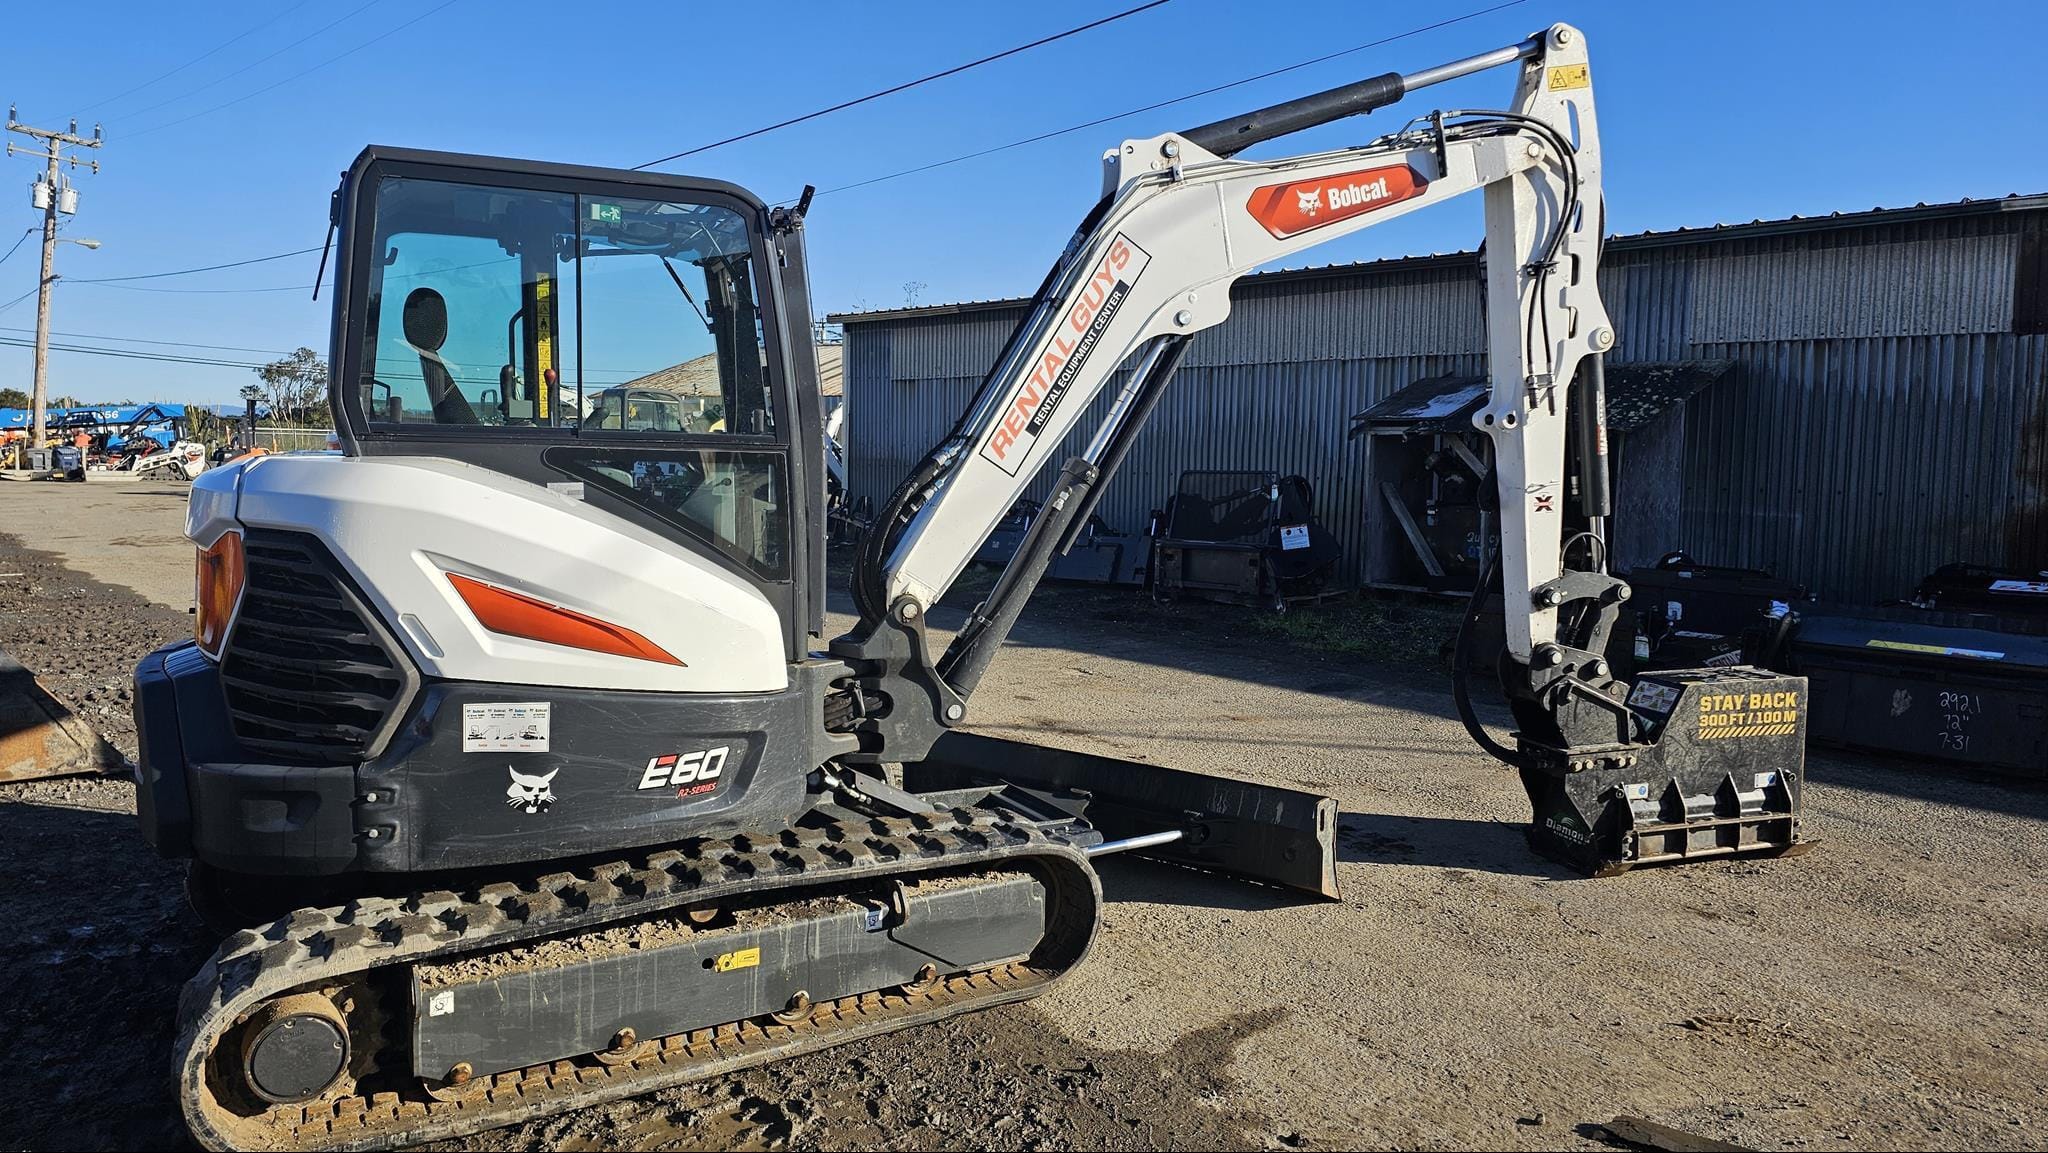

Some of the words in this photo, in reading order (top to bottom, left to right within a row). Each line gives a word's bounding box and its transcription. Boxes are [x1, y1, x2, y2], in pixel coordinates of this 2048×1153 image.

[1328, 177, 1391, 210] Bobcat
[990, 337, 1076, 460] RENTAL
[1071, 240, 1131, 334] GUYS
[1033, 388, 1062, 426] RENTAL
[1058, 331, 1097, 388] EQUIPMENT
[1094, 290, 1123, 331] CENTER
[1700, 694, 1745, 712] STAY
[1749, 692, 1797, 709] BACK
[1699, 714, 1728, 727] 300
[1756, 711, 1782, 724] 100
[1783, 711, 1797, 723] M
[637, 746, 730, 790] E60
[677, 782, 718, 798] R2-SERIES
